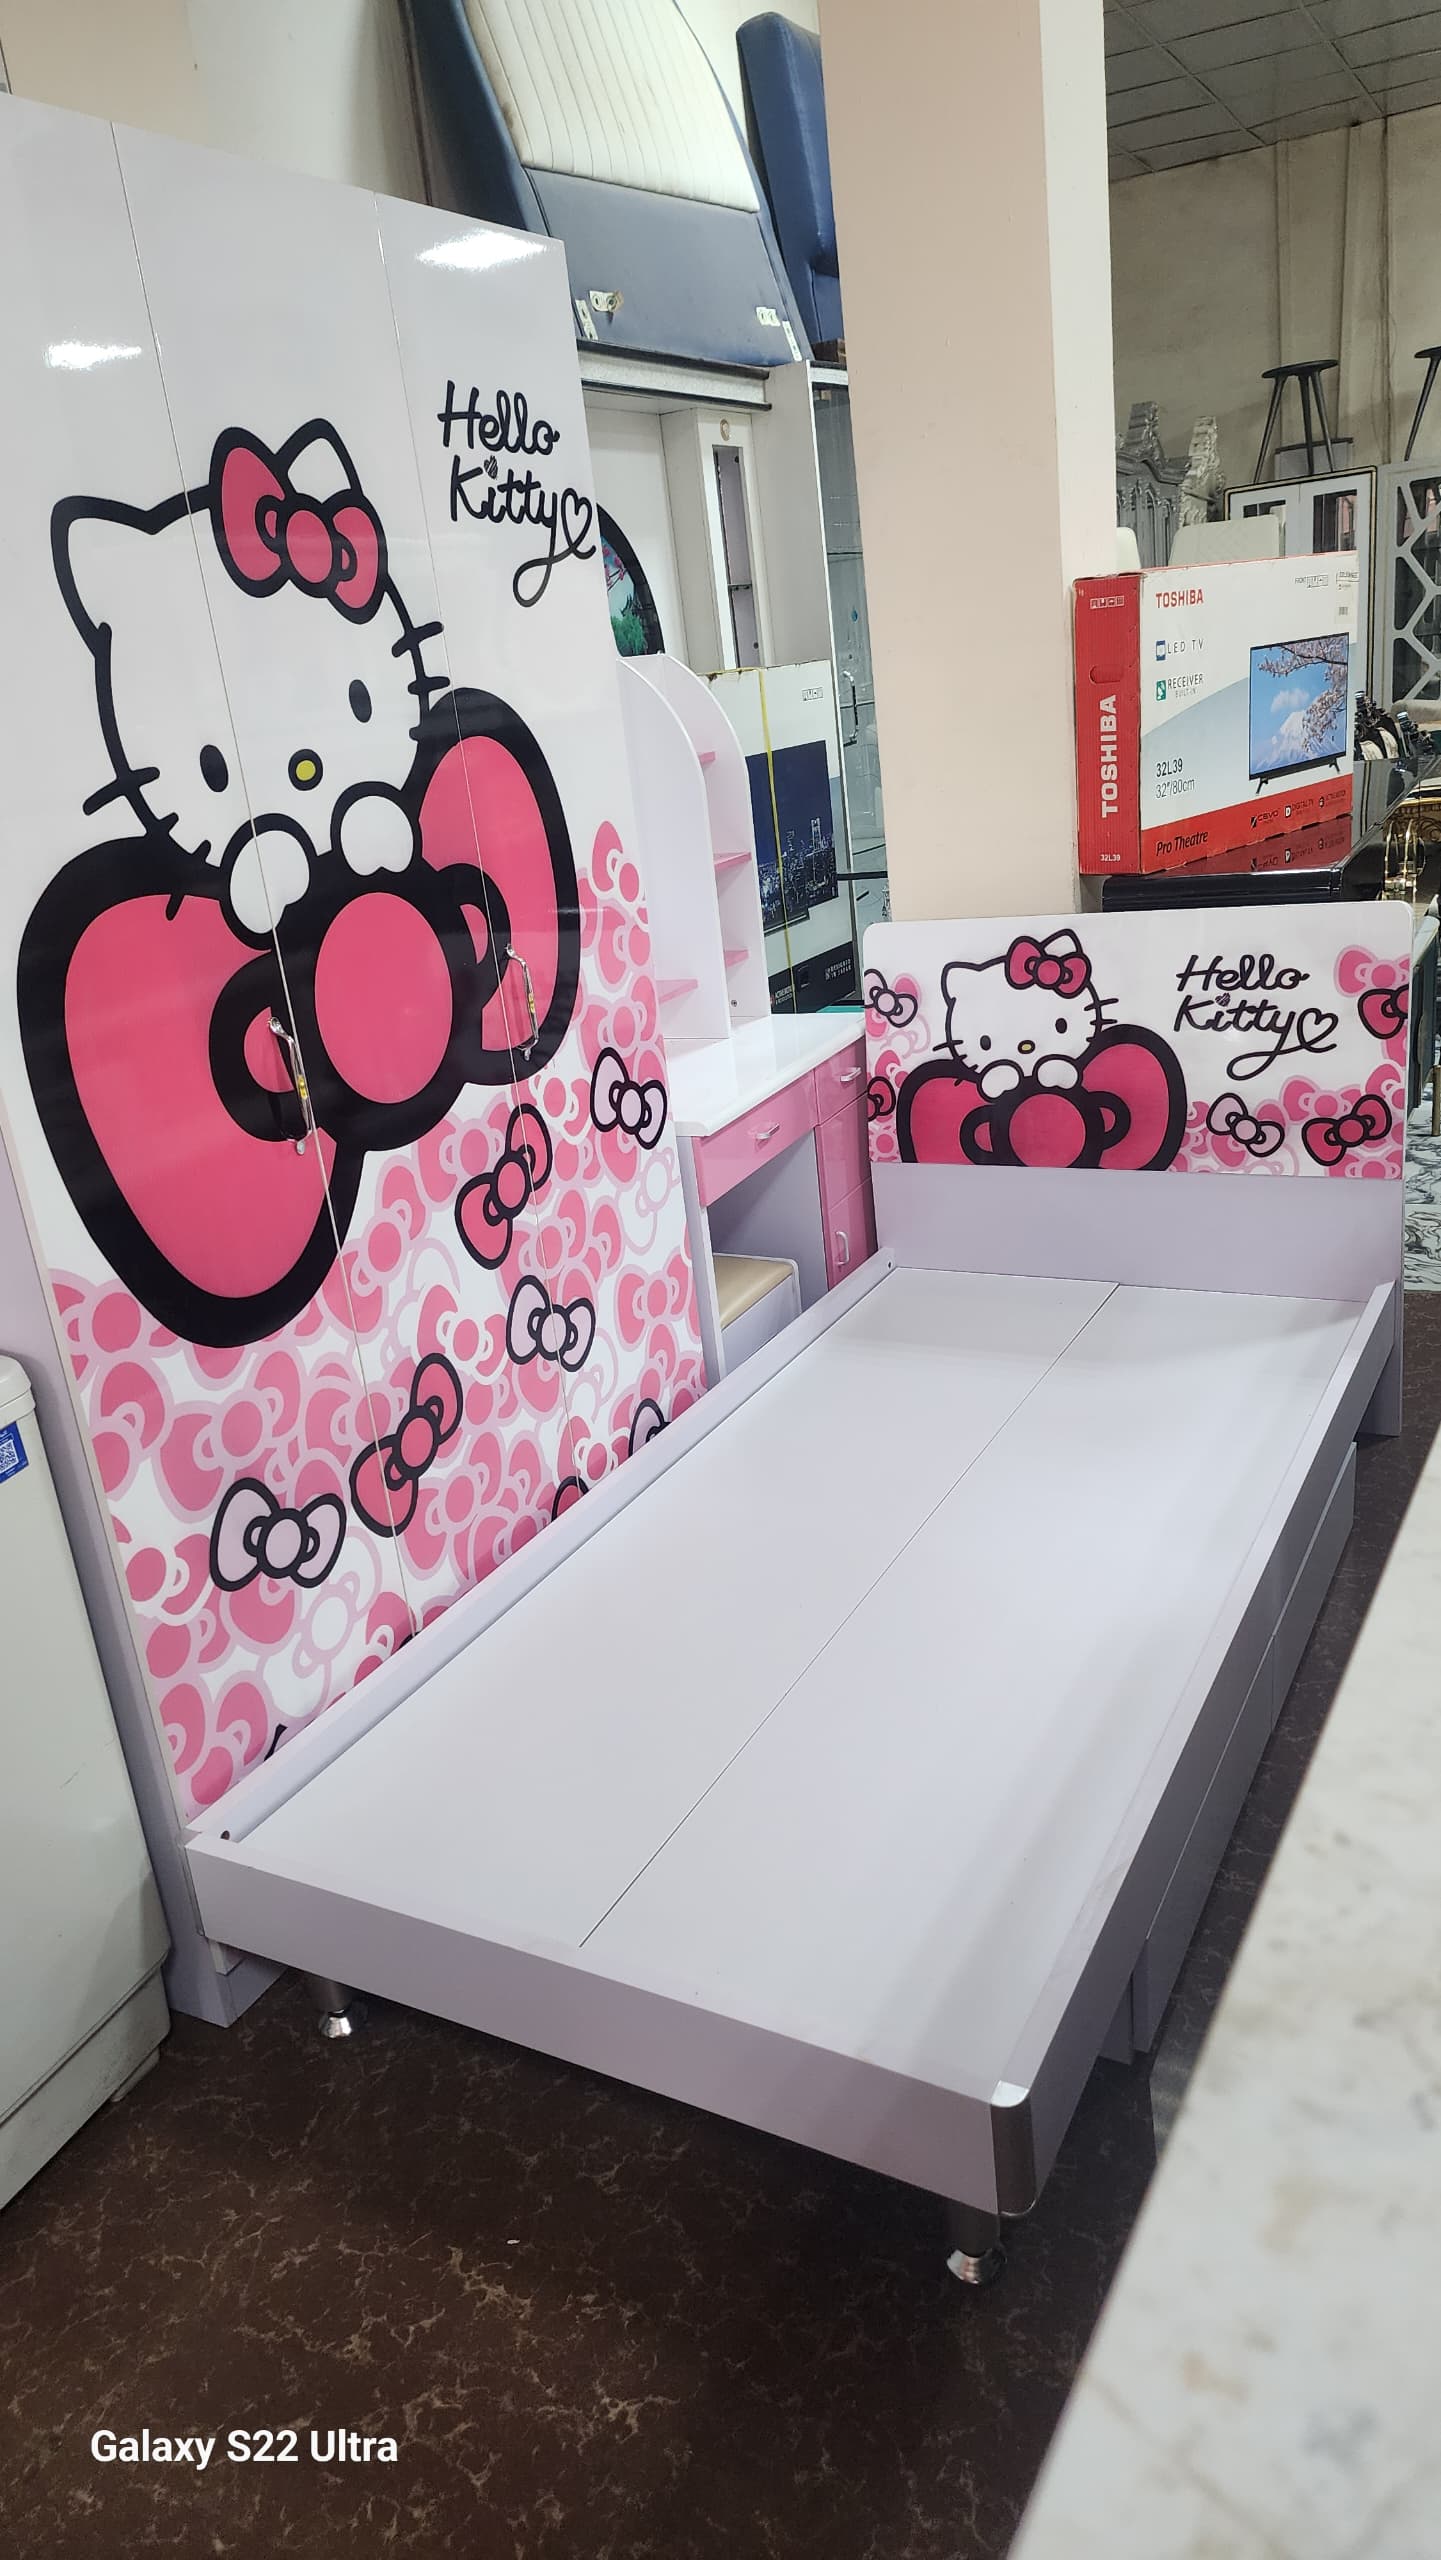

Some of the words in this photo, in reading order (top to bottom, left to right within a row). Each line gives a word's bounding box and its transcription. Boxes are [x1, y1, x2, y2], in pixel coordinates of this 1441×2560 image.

[437, 380, 560, 455] Hello
[450, 454, 597, 607] Kitty
[1155, 588, 1204, 608] TOSHIBA
[1167, 641, 1186, 654] LED
[1191, 638, 1204, 651] TV
[1167, 673, 1204, 689] RECEIVER
[1099, 694, 1118, 818] TOSHIBA
[1156, 758, 1183, 777] 32L39
[1156, 841, 1172, 856] Pro
[1174, 831, 1209, 851] Theatre
[1176, 953, 1310, 991] Hello
[1174, 993, 1338, 1081] Kitty
